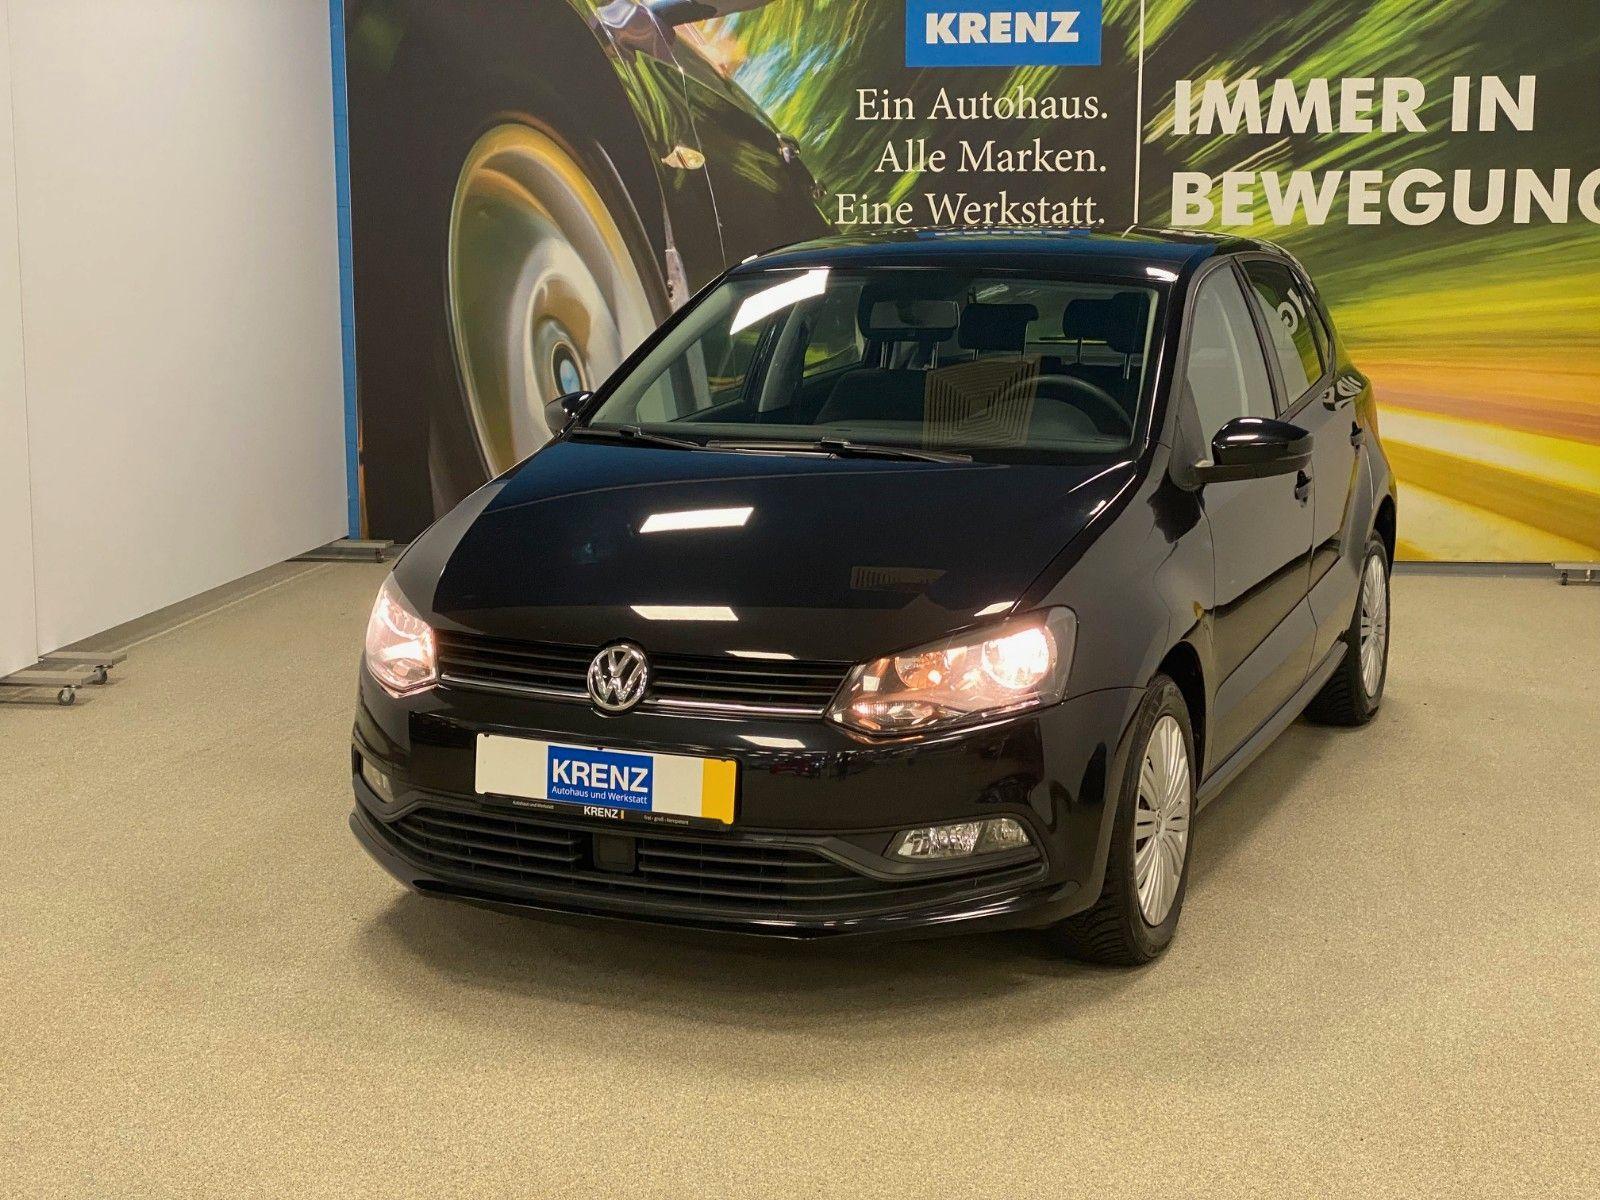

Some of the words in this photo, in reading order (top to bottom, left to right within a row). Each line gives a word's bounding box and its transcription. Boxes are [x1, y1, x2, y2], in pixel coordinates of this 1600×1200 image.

[926, 11, 1080, 44] KRENZ
[855, 88, 914, 120] Ein
[927, 85, 1108, 120] Autohaus.
[1173, 77, 1427, 135] IMMER
[1451, 75, 1536, 132] IN
[874, 140, 946, 173] Alle
[957, 138, 1106, 173] Marken.
[835, 193, 913, 225] Eine
[924, 190, 1105, 225] Werkstatt.
[587, 645, 647, 711] VW
[552, 758, 649, 793] KRENZ
[551, 786, 589, 798] Autohaus
[590, 791, 606, 800] und
[607, 792, 648, 805] Werkstatt
[583, 805, 619, 819] KRENZ
